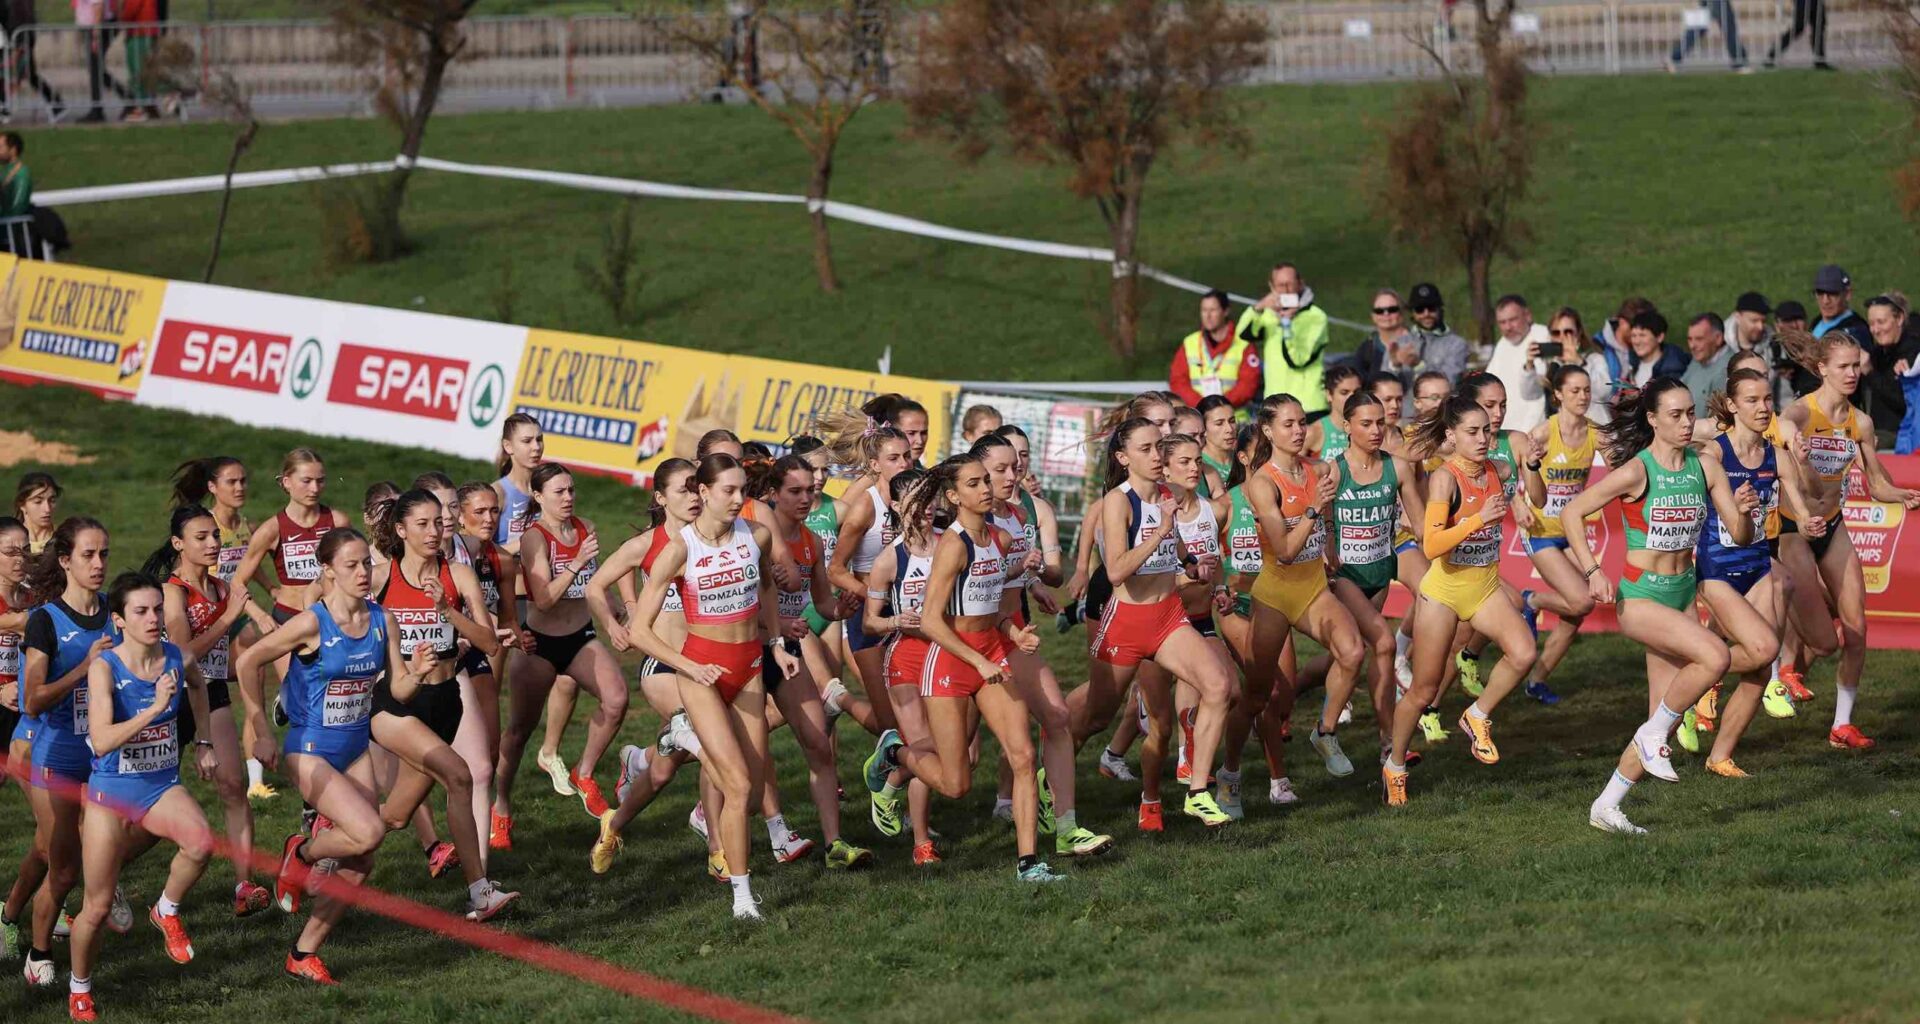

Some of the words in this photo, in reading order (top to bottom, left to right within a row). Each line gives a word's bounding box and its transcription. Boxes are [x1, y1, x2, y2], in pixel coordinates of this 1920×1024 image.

[28, 275, 55, 322] LE
[51, 275, 136, 336] GRUYÈRE
[22, 330, 117, 363] SWITZERLAND
[179, 329, 288, 385] SPAR
[355, 354, 465, 412] SPAR
[519, 345, 552, 397] LE
[548, 345, 655, 413] GRUYÈRE
[753, 377, 792, 434] LE
[517, 408, 633, 443] ITZERLAND
[1811, 437, 1846, 451] SPAR
[1653, 493, 1703, 507] PORTUGAL
[1652, 509, 1696, 521] SPAR
[1844, 508, 1870, 521] PAR
[1342, 526, 1381, 539] SPAR
[1234, 538, 1259, 548] SPA
[1342, 539, 1390, 552] O'CONNOR
[1652, 541, 1681, 549] LAGOA
[695, 556, 713, 568] 4F
[1345, 555, 1372, 564] LAGOA
[971, 560, 999, 576] SPAR
[699, 569, 745, 588] SPAR
[1658, 576, 1670, 585] CA
[704, 603, 737, 614] LAGOA
[345, 661, 377, 674] ITALIA
[327, 714, 356, 725] LAGOA
[123, 738, 177, 760] SETTINO
[125, 763, 159, 772] LAGOA
